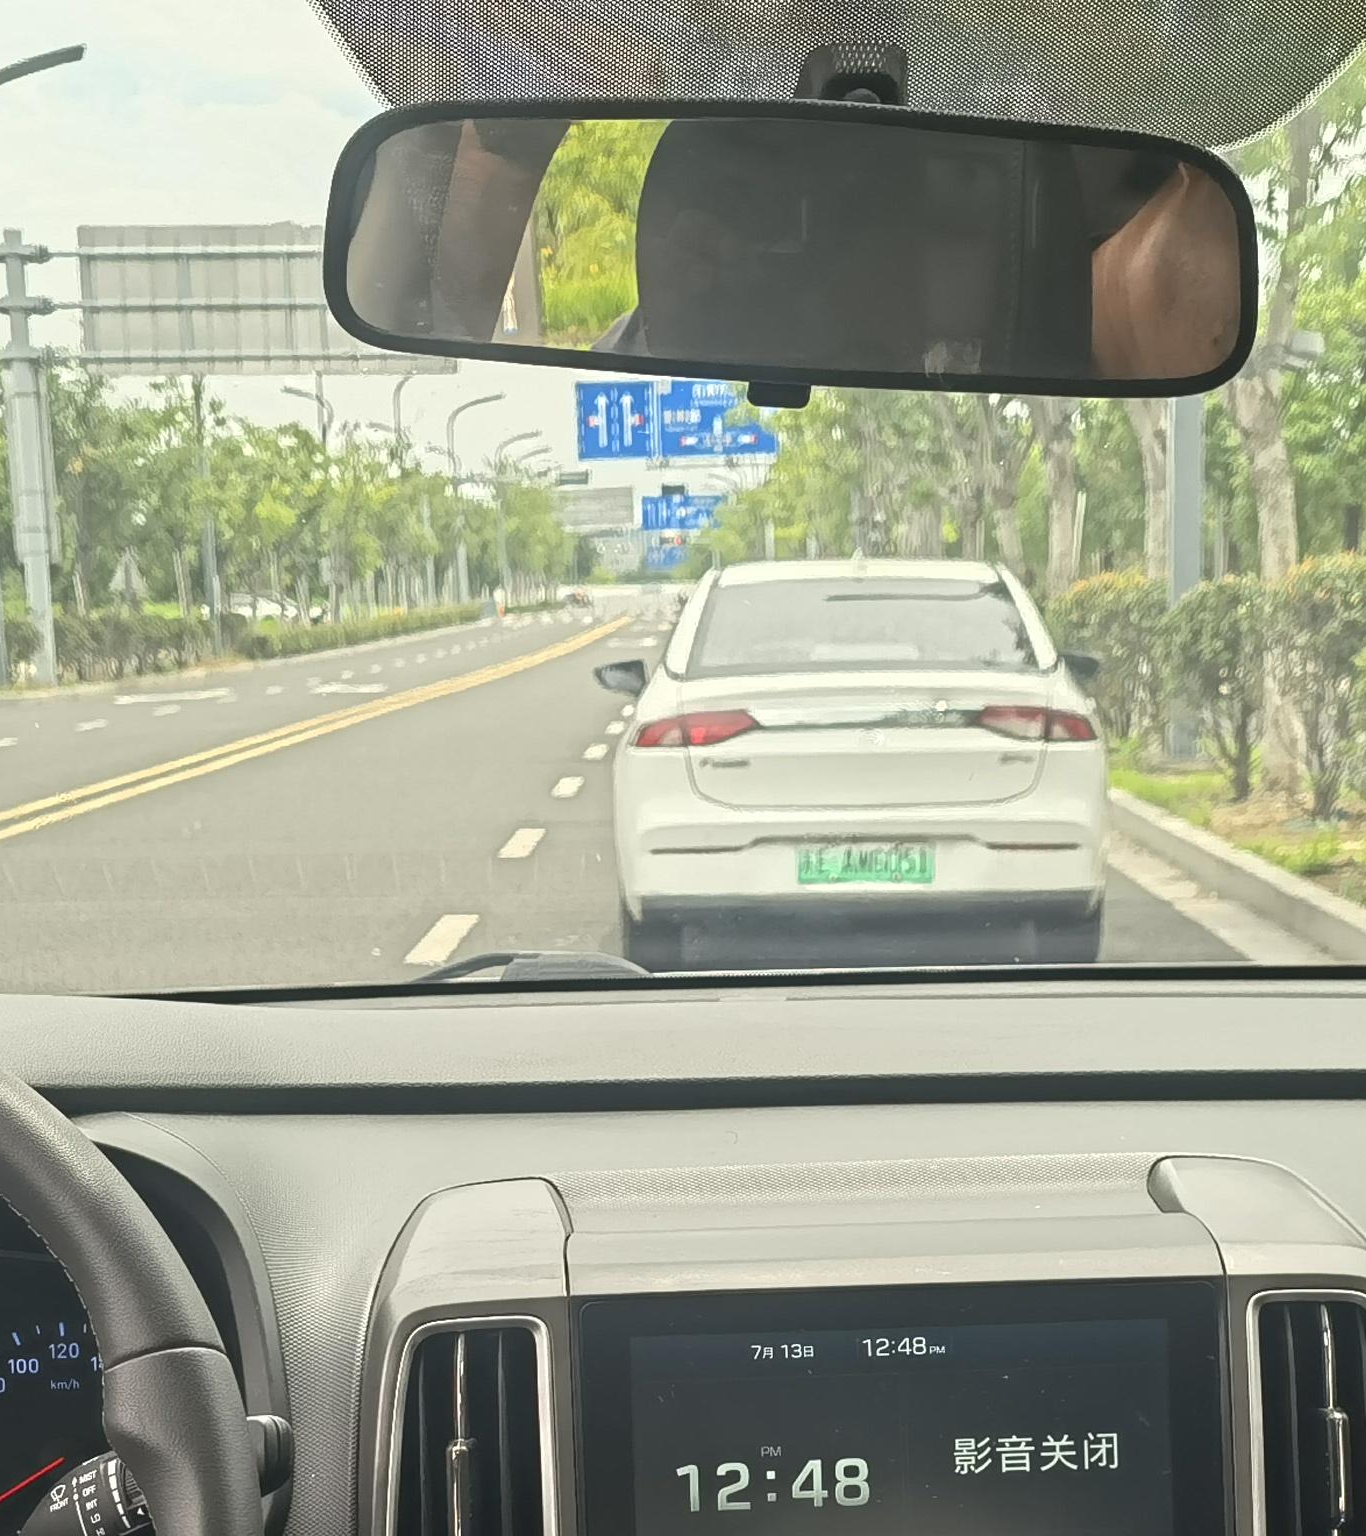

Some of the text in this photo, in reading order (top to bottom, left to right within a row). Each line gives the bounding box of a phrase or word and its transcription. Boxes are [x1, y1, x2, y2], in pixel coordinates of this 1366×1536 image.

[48, 1342, 80, 1359] 120
[750, 1343, 814, 1360] 7月 13日
[862, 1336, 946, 1357] 12:48 PM
[7, 1358, 39, 1374] 100
[50, 1378, 80, 1390] km/h
[761, 1446, 782, 1457] PM
[953, 1432, 1119, 1475] 影音关闭
[82, 1484, 97, 1497] OFF
[676, 1457, 870, 1512] 12:48
[50, 1498, 69, 1512] FRONT
